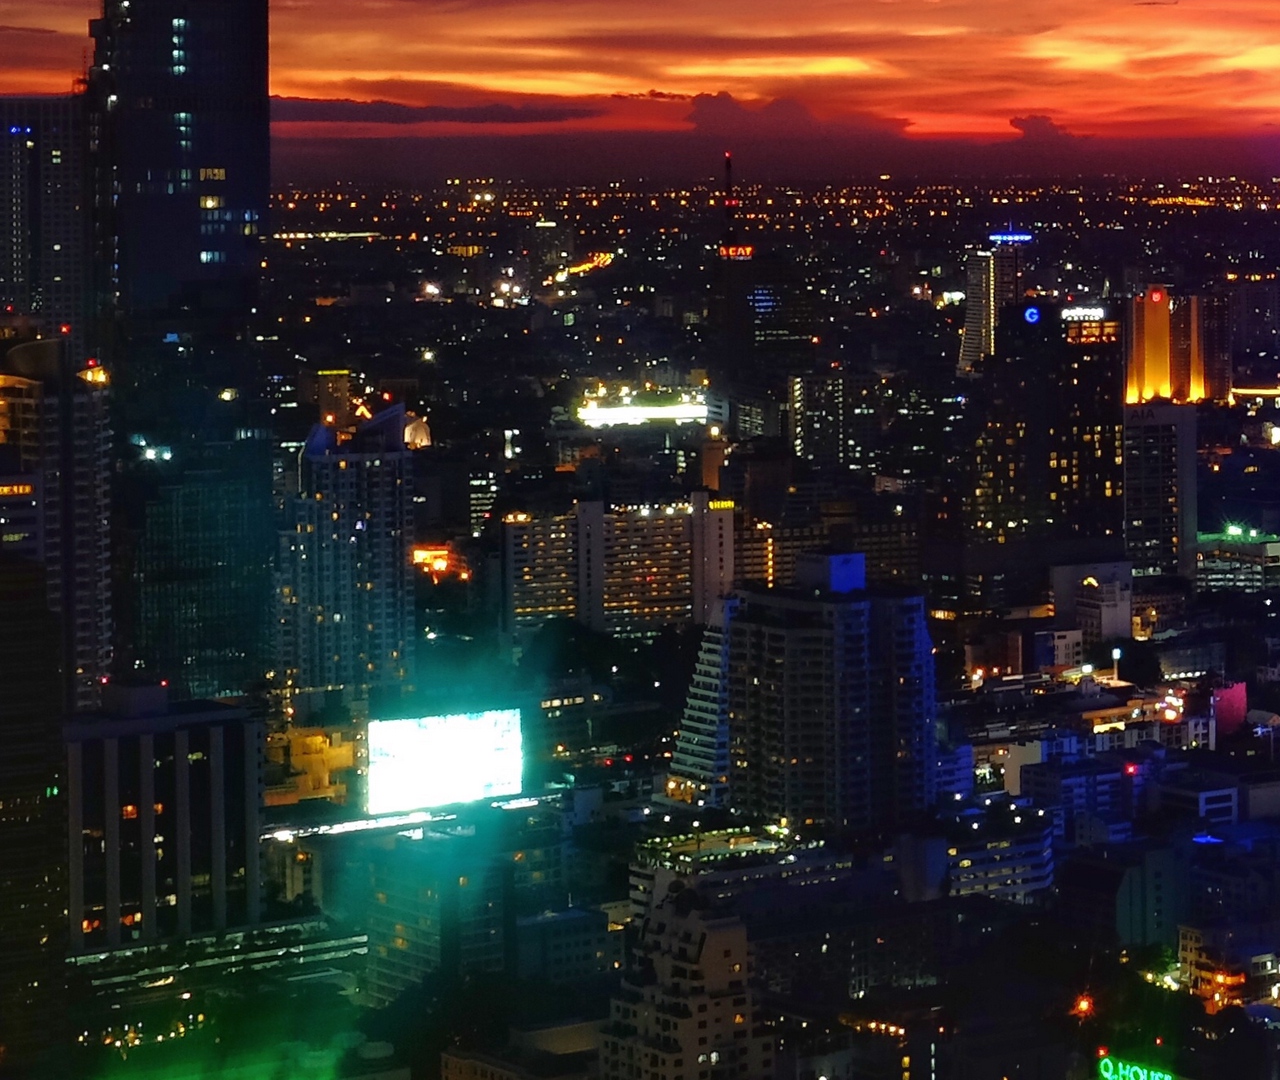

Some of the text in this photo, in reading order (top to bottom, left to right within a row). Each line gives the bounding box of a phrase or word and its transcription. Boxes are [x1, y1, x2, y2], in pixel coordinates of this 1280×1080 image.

[728, 246, 753, 256] CAT
[1024, 308, 1039, 323] G
[1131, 409, 1155, 420] AIA
